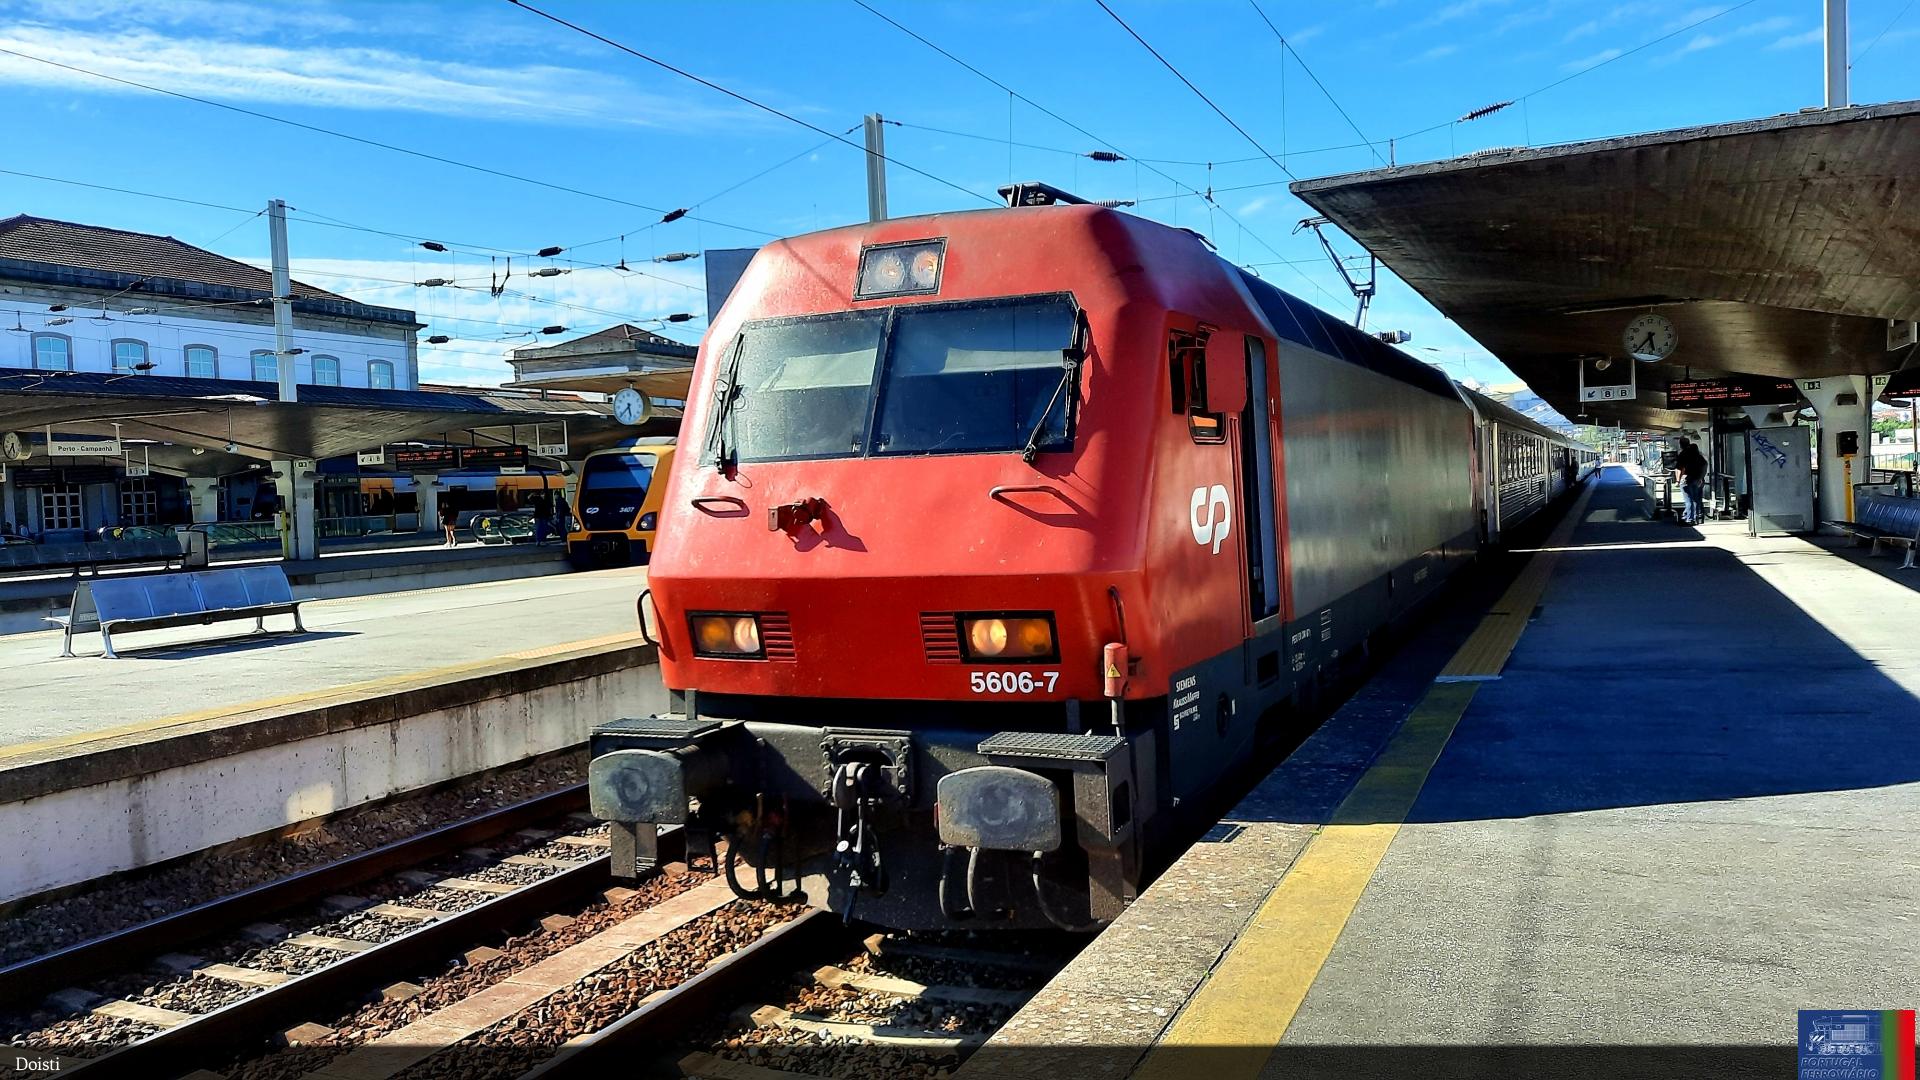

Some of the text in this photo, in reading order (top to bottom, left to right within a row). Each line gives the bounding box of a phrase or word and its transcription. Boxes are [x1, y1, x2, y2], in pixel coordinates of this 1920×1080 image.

[1604, 389, 1627, 398] 8 B
[970, 671, 1060, 694] 5606-7
[1175, 675, 1196, 692] SIEMENS
